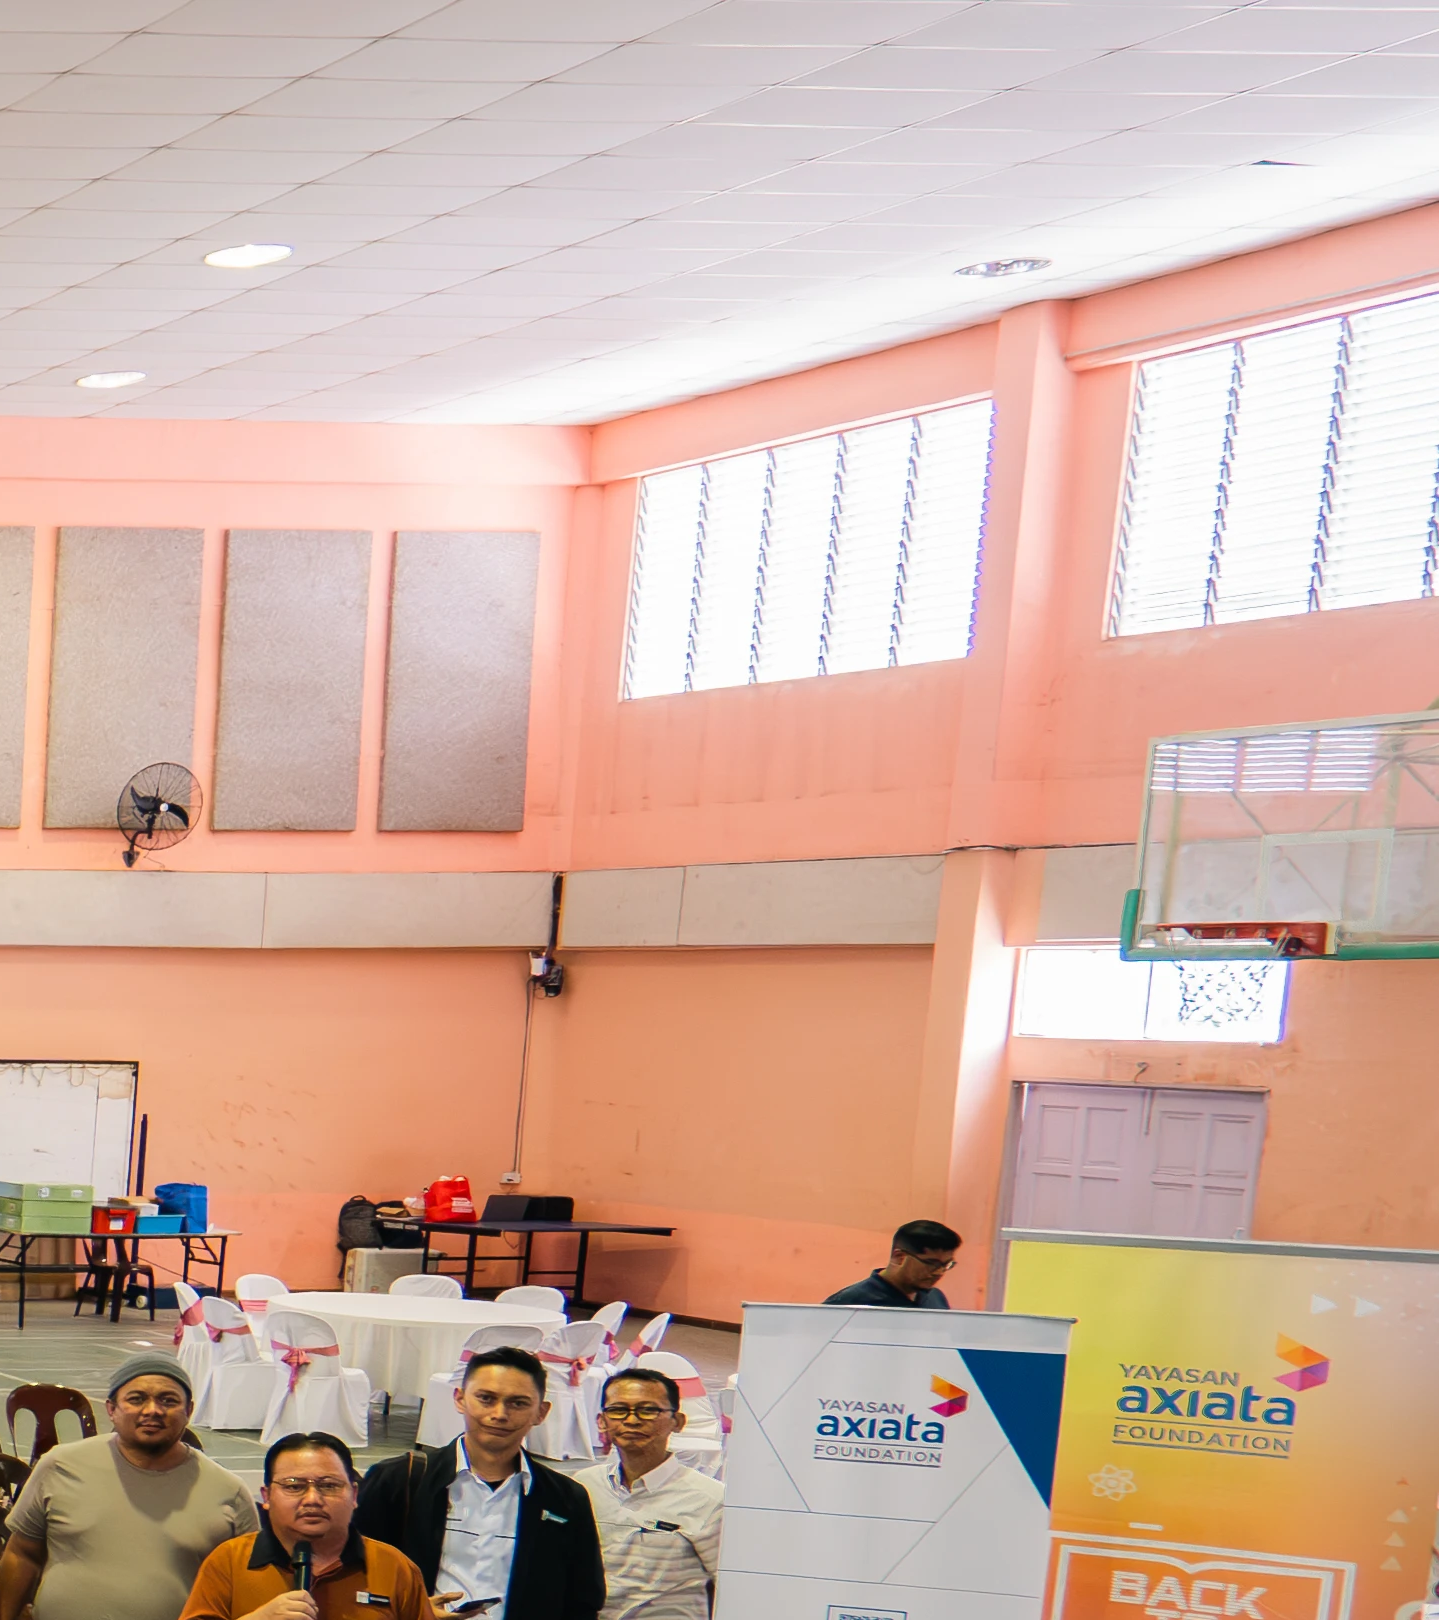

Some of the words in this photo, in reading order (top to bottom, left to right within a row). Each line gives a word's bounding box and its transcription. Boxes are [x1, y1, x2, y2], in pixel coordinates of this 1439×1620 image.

[1119, 1363, 1240, 1387] YAYASAN
[818, 1398, 905, 1415] YAYASAN
[1116, 1385, 1296, 1426] axiata
[816, 1413, 945, 1443] axiata
[1114, 1424, 1291, 1452] FOUNDATION
[814, 1444, 942, 1463] FOUNDATION
[1109, 1570, 1268, 1620] BACK
